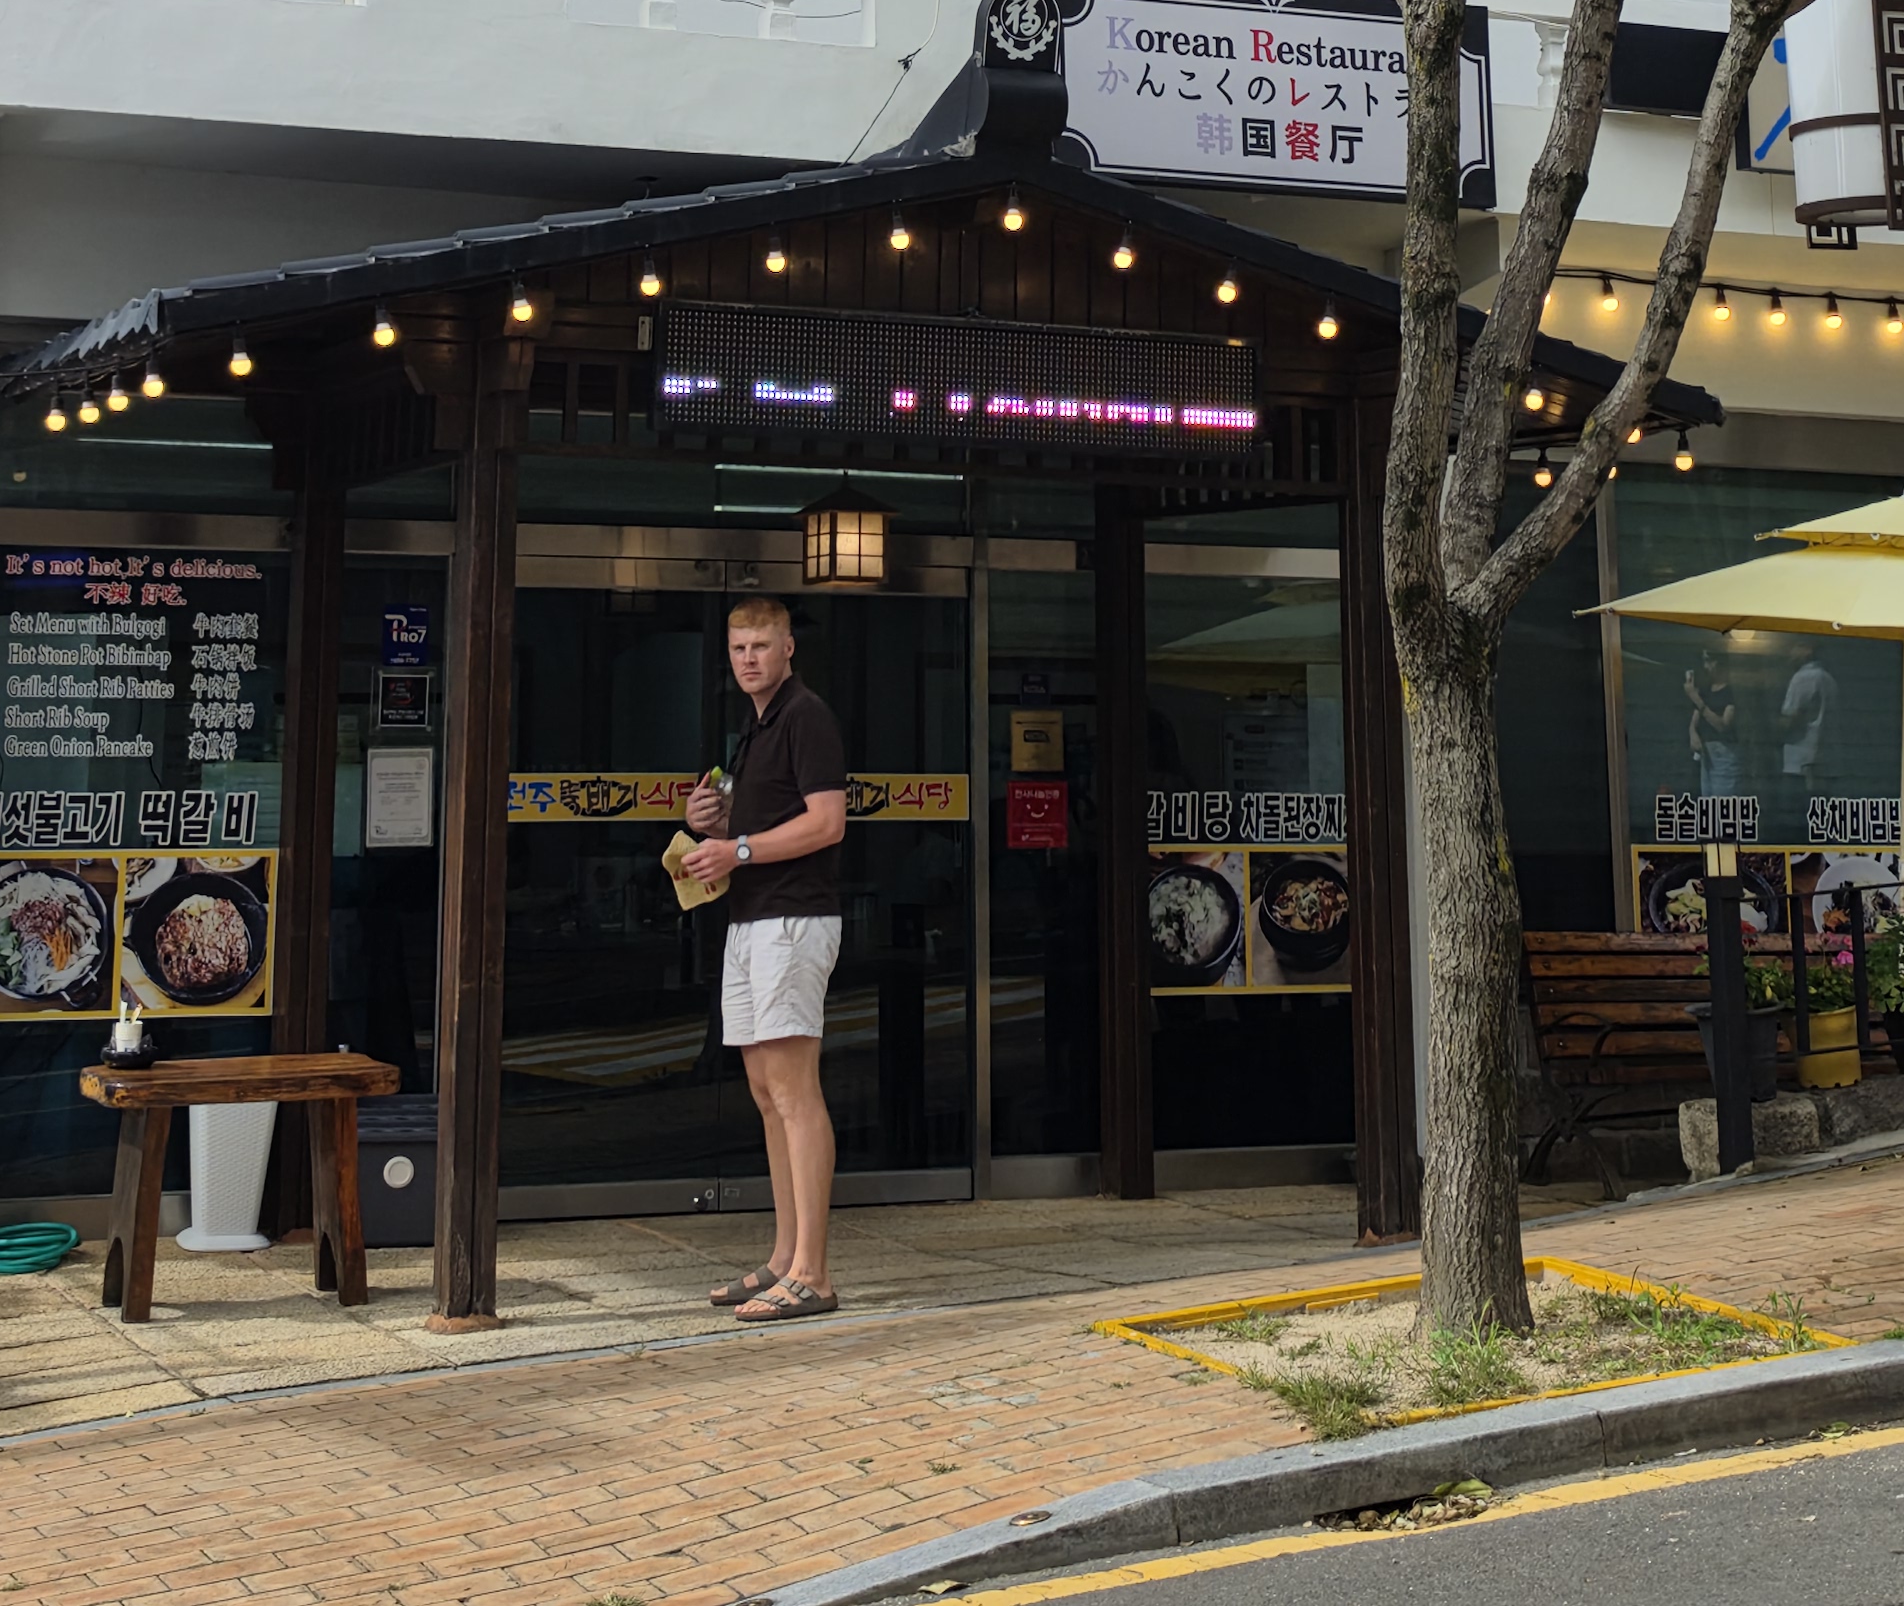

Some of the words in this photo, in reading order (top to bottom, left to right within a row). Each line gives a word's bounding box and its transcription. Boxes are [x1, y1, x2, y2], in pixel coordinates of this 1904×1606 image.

[1105, 15, 1237, 61] Korean
[1249, 27, 1407, 75] Restaura
[1195, 112, 1364, 165] 韩国餐厅
[49, 557, 84, 575] not
[169, 558, 262, 579] delicious.
[9, 611, 34, 634] Set
[34, 612, 76, 634] Menu
[77, 612, 110, 635] with
[111, 612, 166, 640] Bulgogi
[8, 643, 37, 665] Hot
[37, 644, 78, 665] Stone
[79, 643, 104, 665] Pot
[105, 643, 172, 670] Bibimbap
[7, 675, 57, 698] Grilled
[58, 675, 98, 698] Short
[99, 675, 126, 698] Rib
[126, 676, 175, 699] Patties
[4, 705, 45, 728] Short
[46, 705, 72, 728] Rib
[73, 705, 110, 733] Soup
[4, 735, 48, 757] Green
[49, 735, 95, 757] Onion
[96, 734, 154, 757] Pancake
[892, 781, 953, 811] 식당
[1239, 792, 1347, 842] 차돌된장찌
[1655, 793, 1760, 842] 돌솥비빔밥
